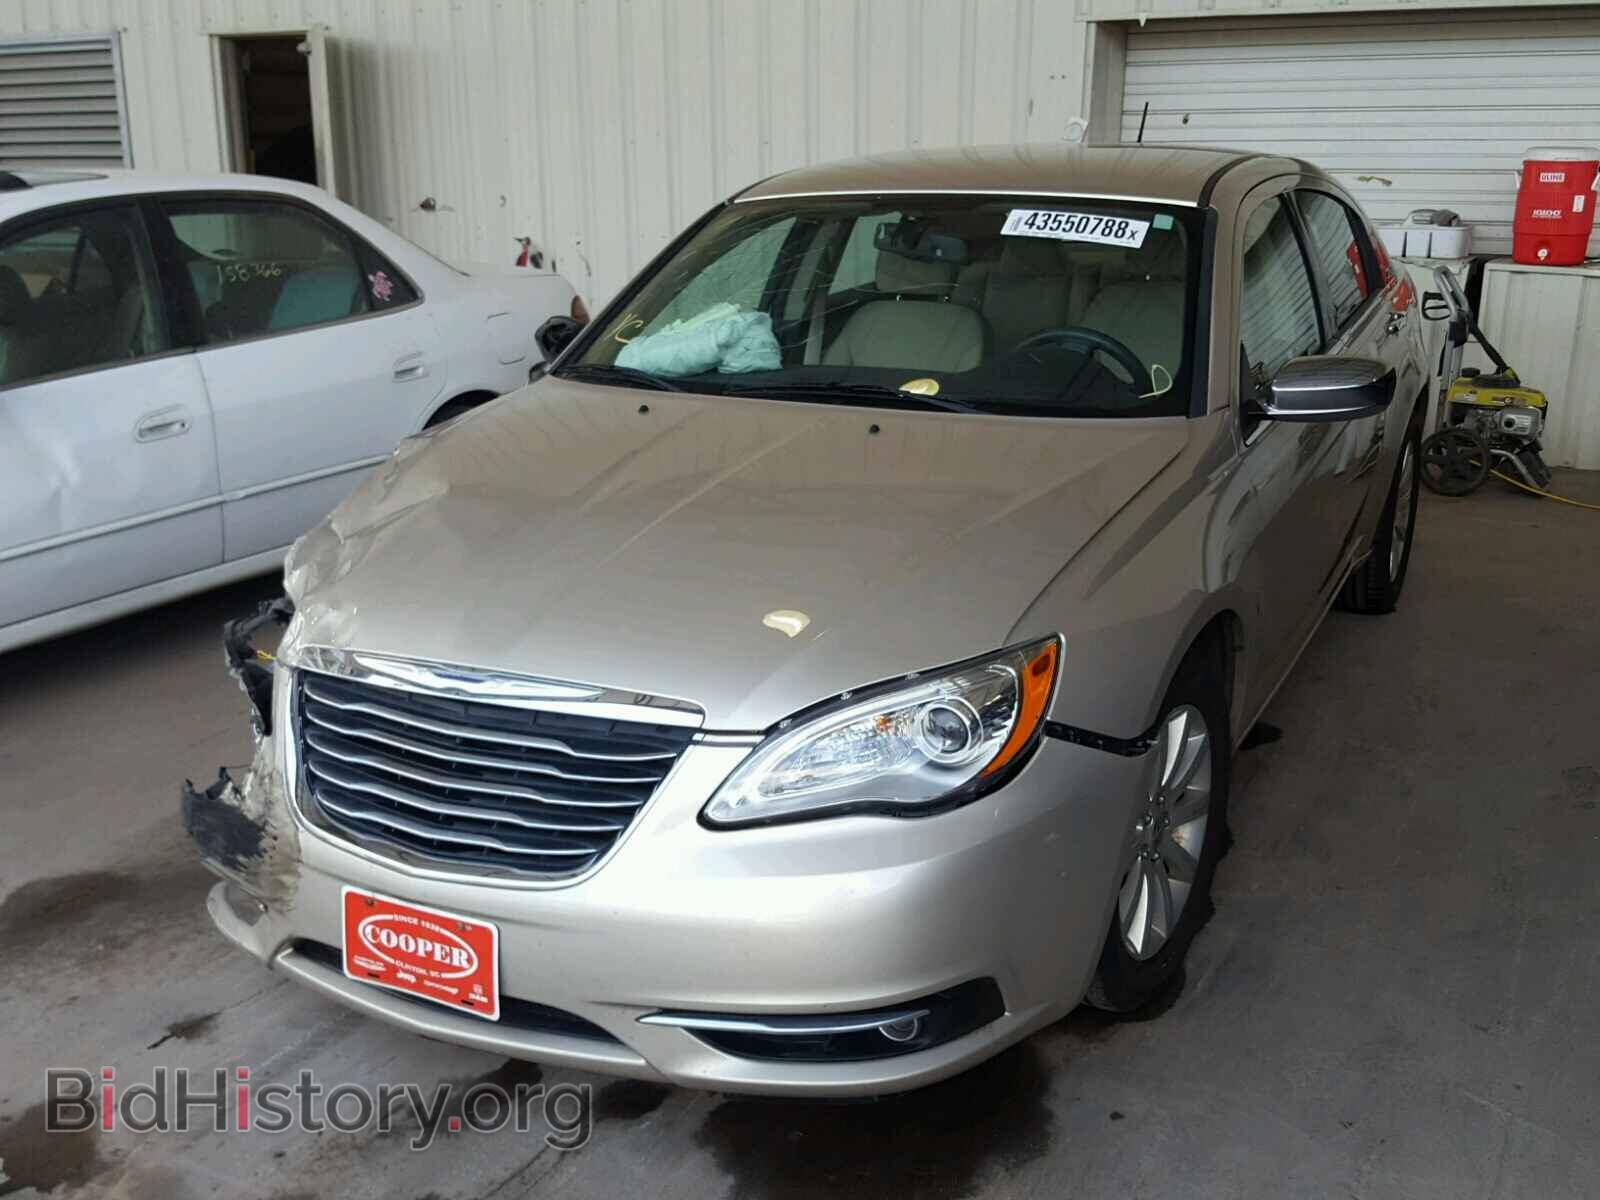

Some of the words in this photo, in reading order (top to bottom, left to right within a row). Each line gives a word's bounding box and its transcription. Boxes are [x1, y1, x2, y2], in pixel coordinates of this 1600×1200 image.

[1024, 212, 1129, 239] 43550788
[393, 914, 419, 926] SINCE
[364, 925, 470, 969] COOPER
